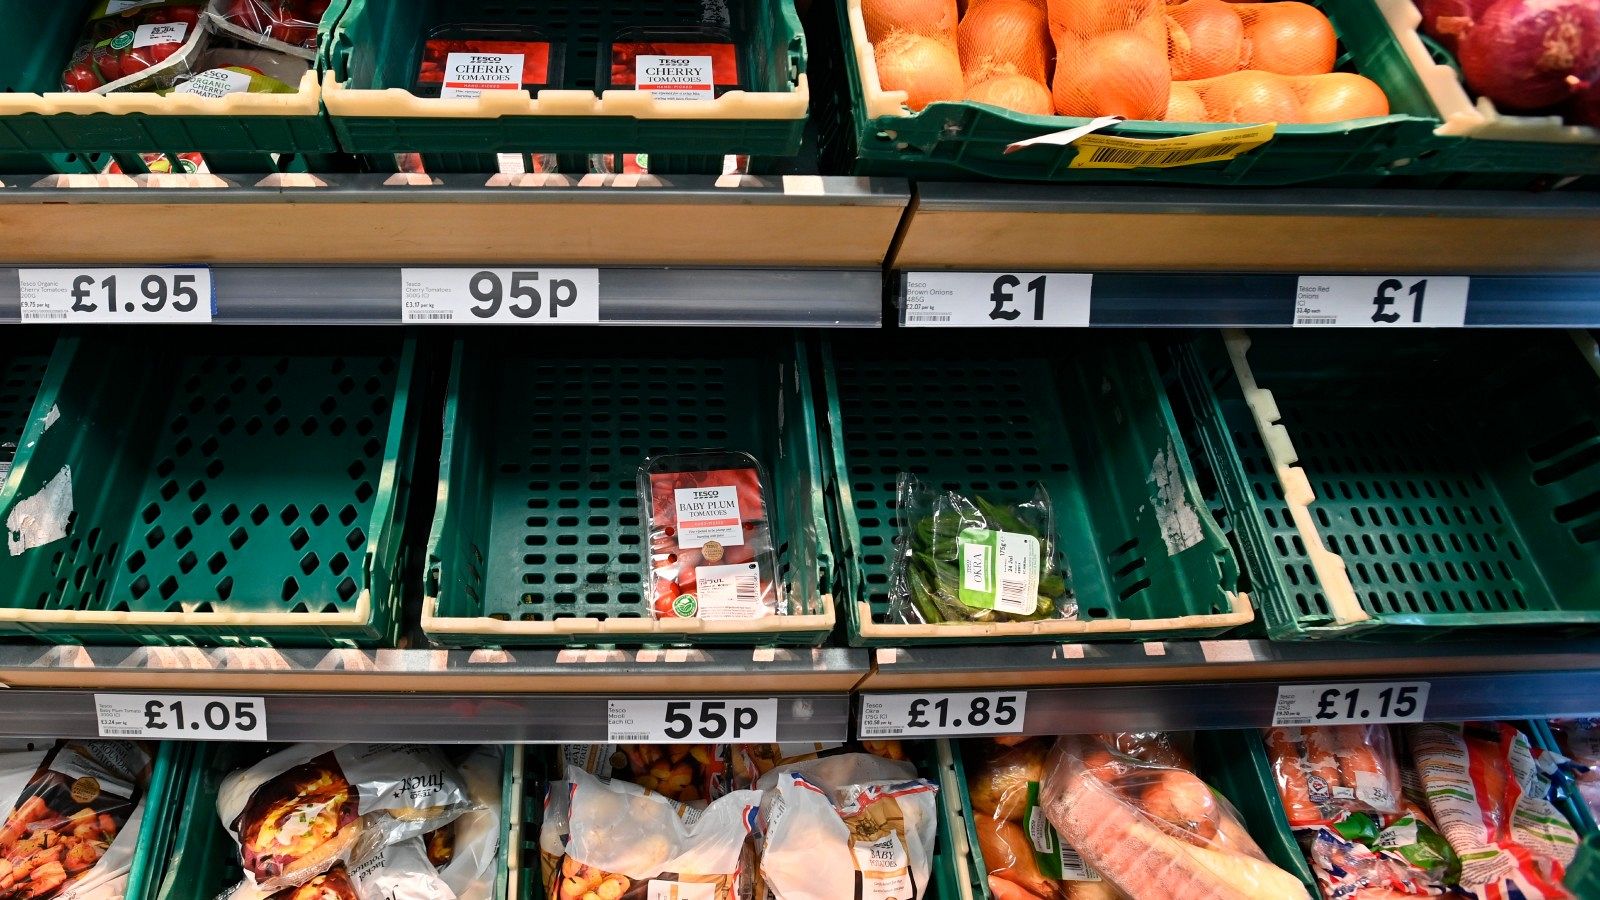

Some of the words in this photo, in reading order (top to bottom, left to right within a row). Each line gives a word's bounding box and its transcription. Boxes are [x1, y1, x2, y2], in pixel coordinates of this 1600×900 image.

[456, 64, 513, 74] CHERRY
[646, 67, 702, 76] CHERRY
[190, 77, 231, 91] ORGANIC
[192, 82, 224, 95] CHERRY
[71, 274, 198, 312] £1.95
[469, 270, 578, 318] 95p
[988, 274, 1046, 320] £1
[1371, 278, 1428, 322] £1
[679, 502, 706, 512] BABY
[708, 500, 736, 510] PLUM
[692, 490, 719, 500] TESCO
[689, 510, 728, 518] TOMATOES
[974, 552, 982, 584] OKRA
[907, 696, 1017, 728] £1.85
[1316, 686, 1419, 720] £1.15
[144, 700, 258, 732] £1.05
[664, 702, 758, 739] 55p
[400, 771, 444, 793] finest
[410, 788, 432, 800] TESCO
[358, 859, 386, 882] Jacket
